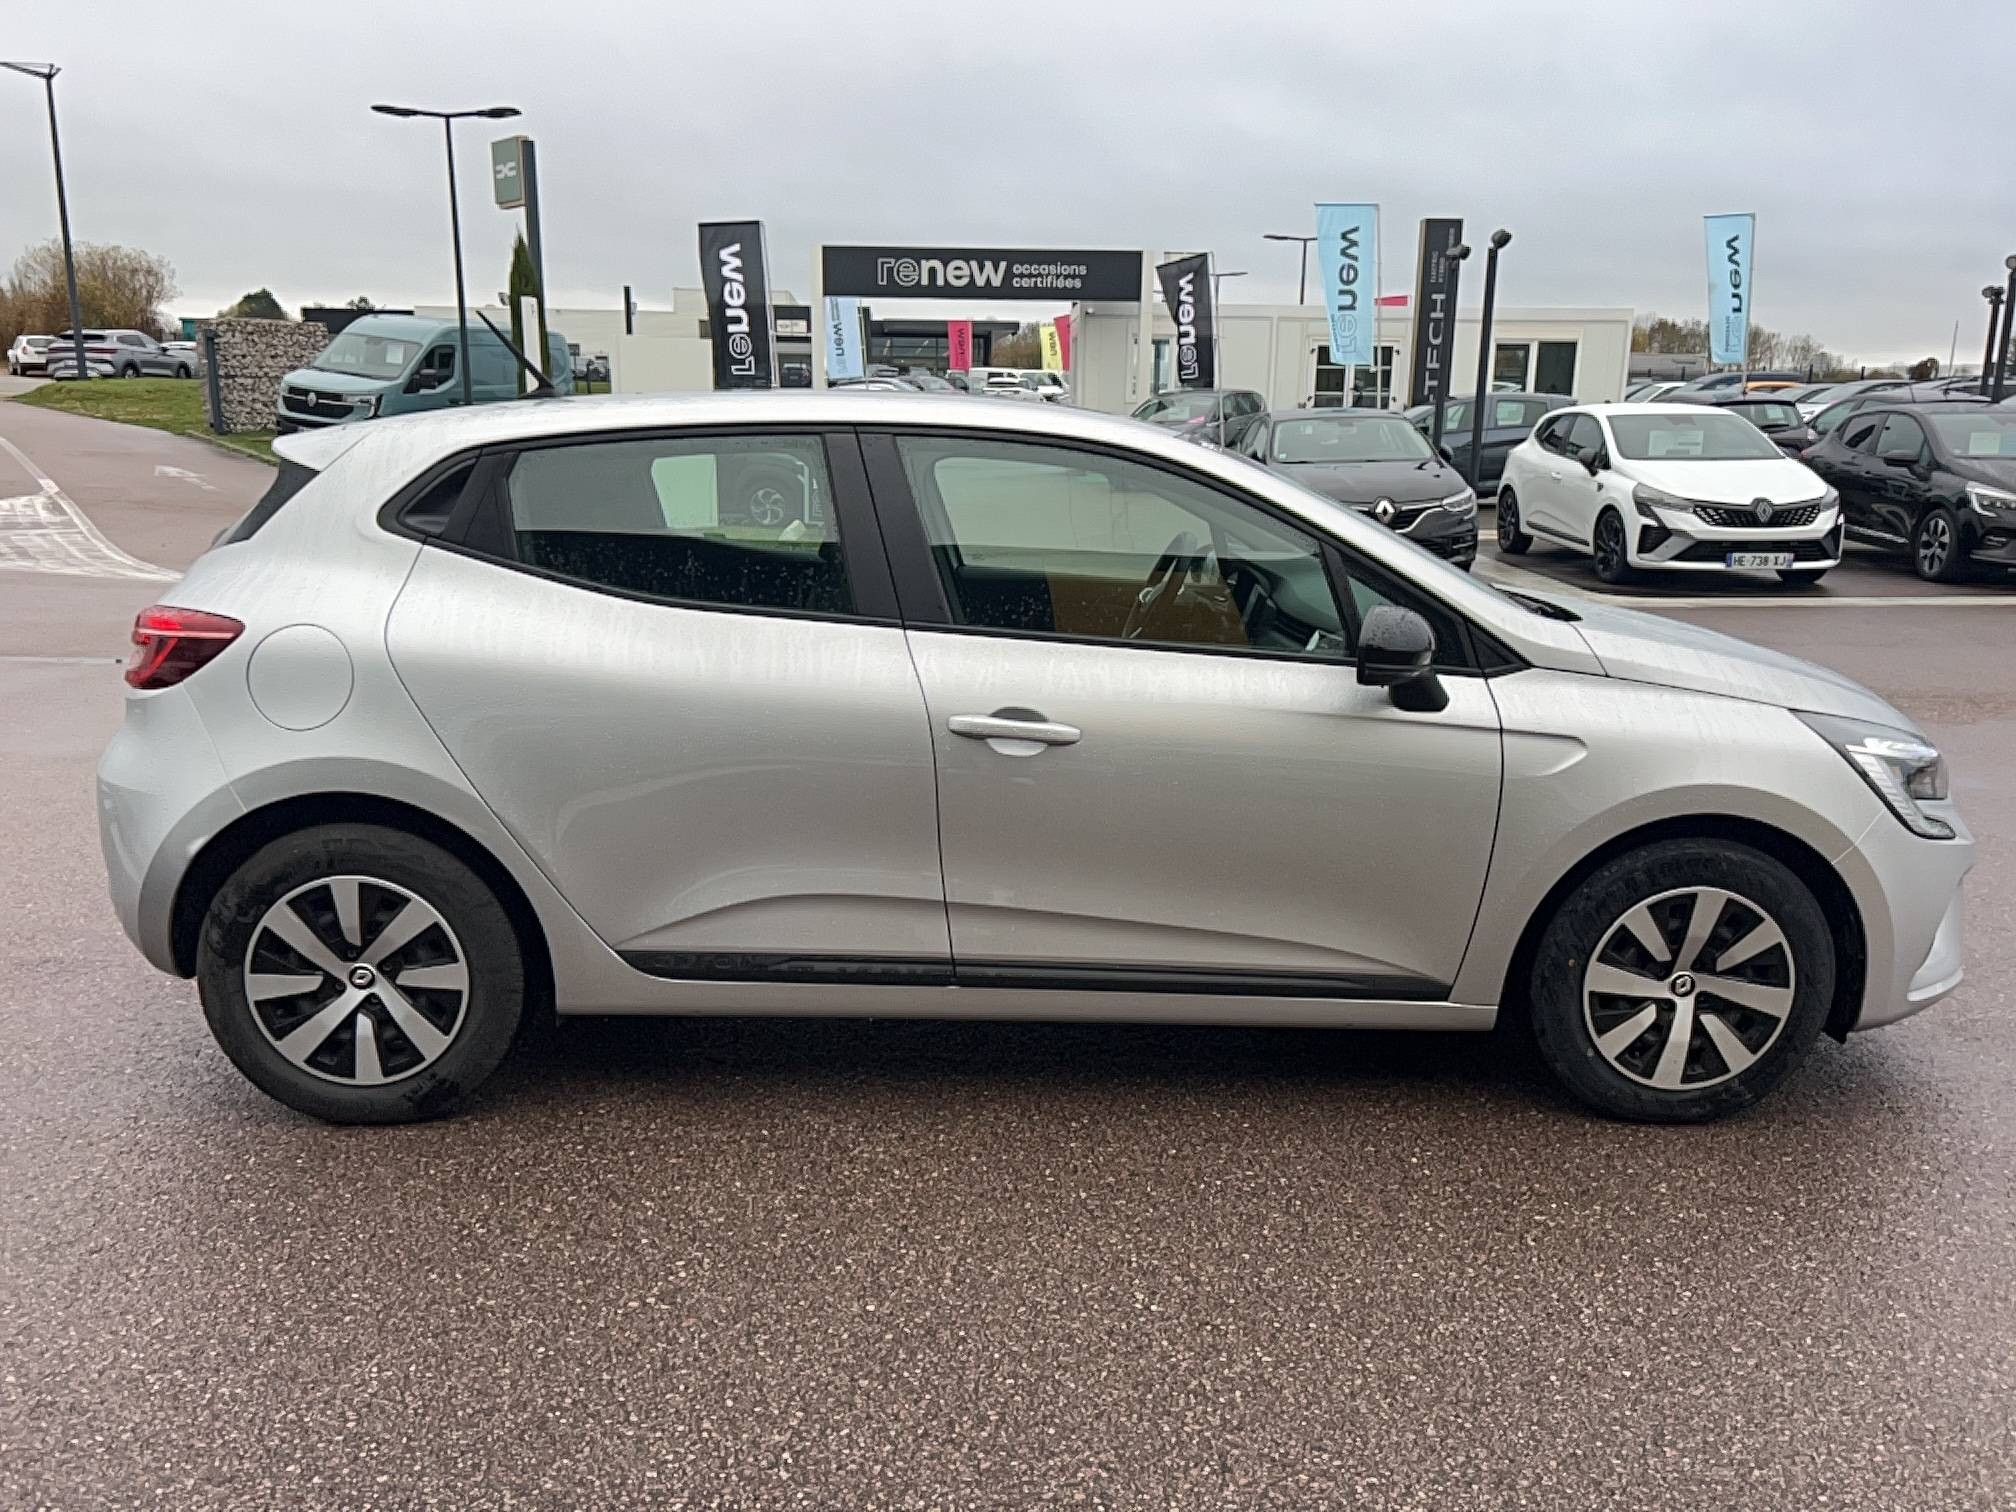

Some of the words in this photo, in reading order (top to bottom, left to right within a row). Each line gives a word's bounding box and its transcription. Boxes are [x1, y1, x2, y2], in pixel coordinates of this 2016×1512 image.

[877, 258, 1007, 287] renew
[1012, 261, 1087, 276] occasions
[1012, 274, 1082, 289] certifiées
[1733, 555, 1746, 567] HE
[1750, 554, 1770, 567] 738
